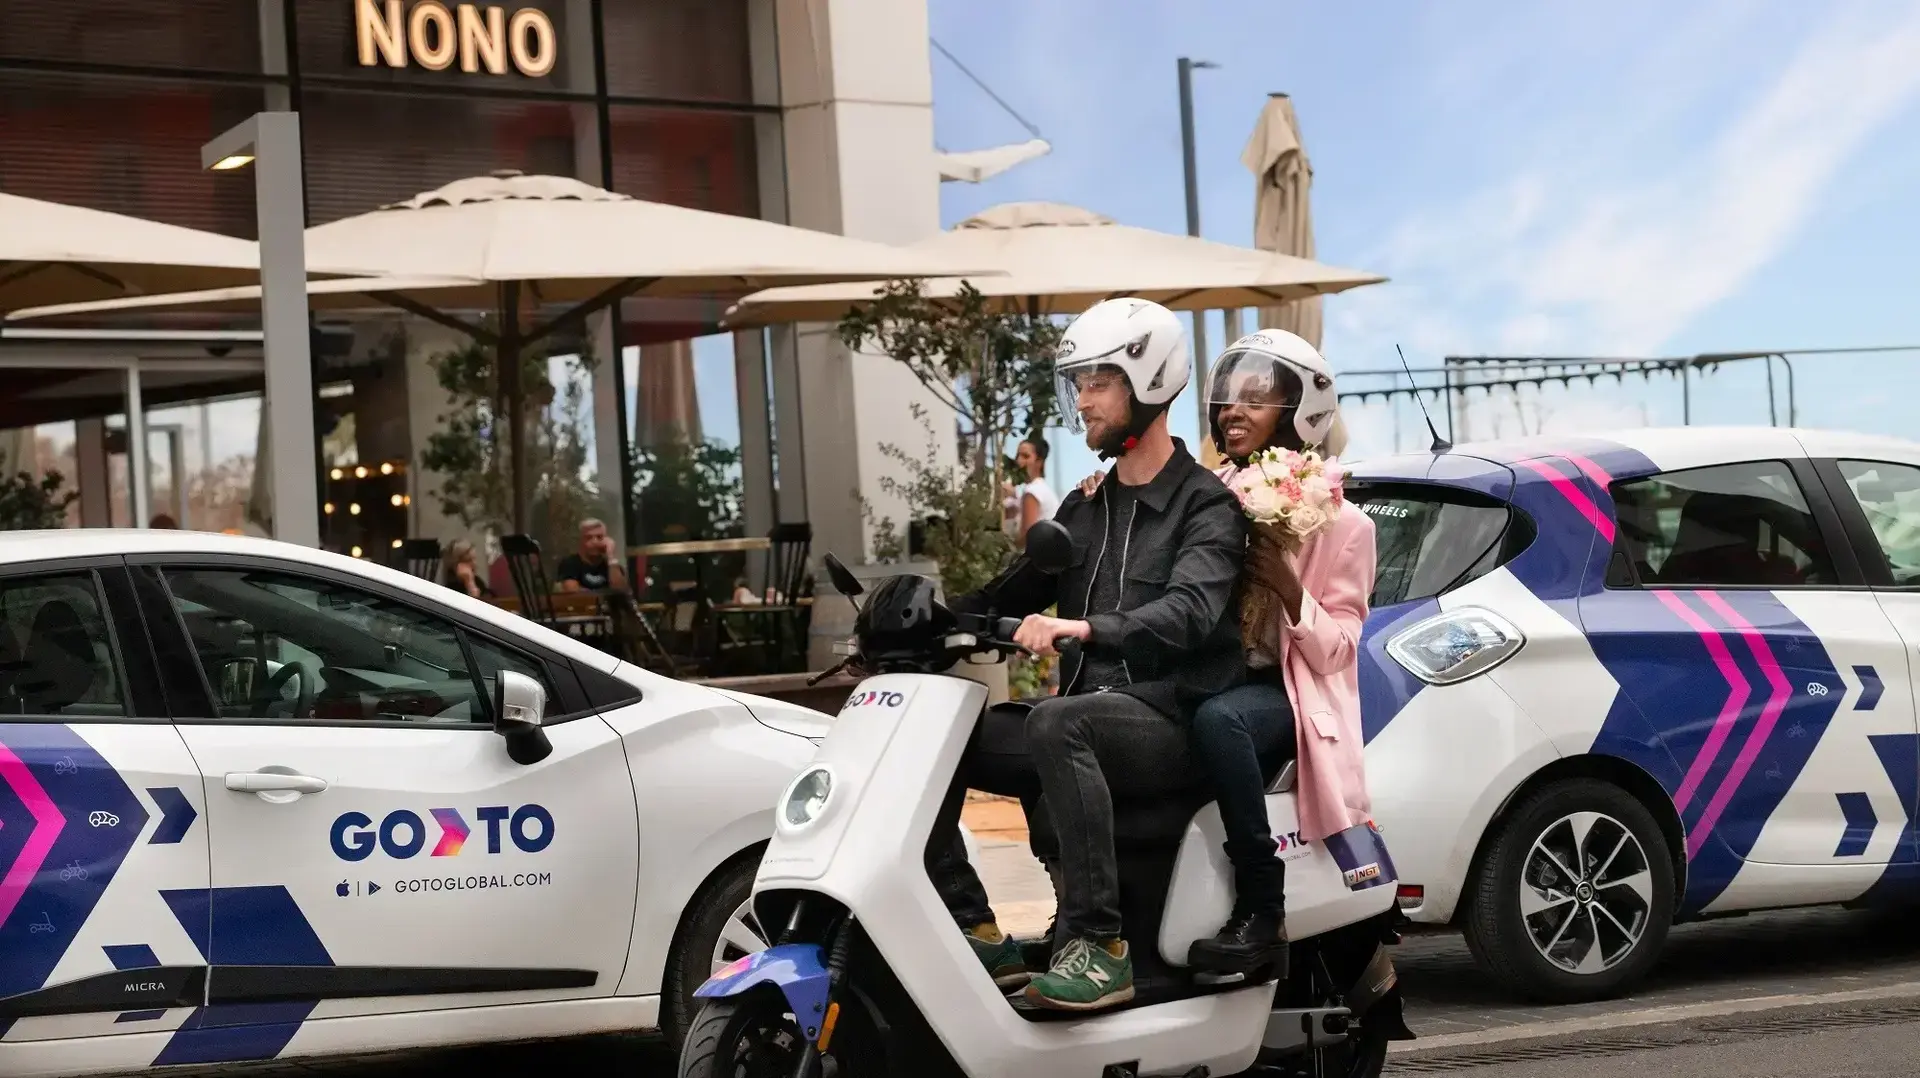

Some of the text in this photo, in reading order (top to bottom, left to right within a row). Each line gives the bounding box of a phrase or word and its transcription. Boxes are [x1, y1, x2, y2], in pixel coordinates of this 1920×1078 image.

[354, 0, 557, 78] NONO
[1361, 503, 1409, 518] WHEELS
[394, 872, 551, 894] GOTOGLOBAL.COM
[124, 982, 166, 992] MICRA
[1085, 963, 1111, 989] N
